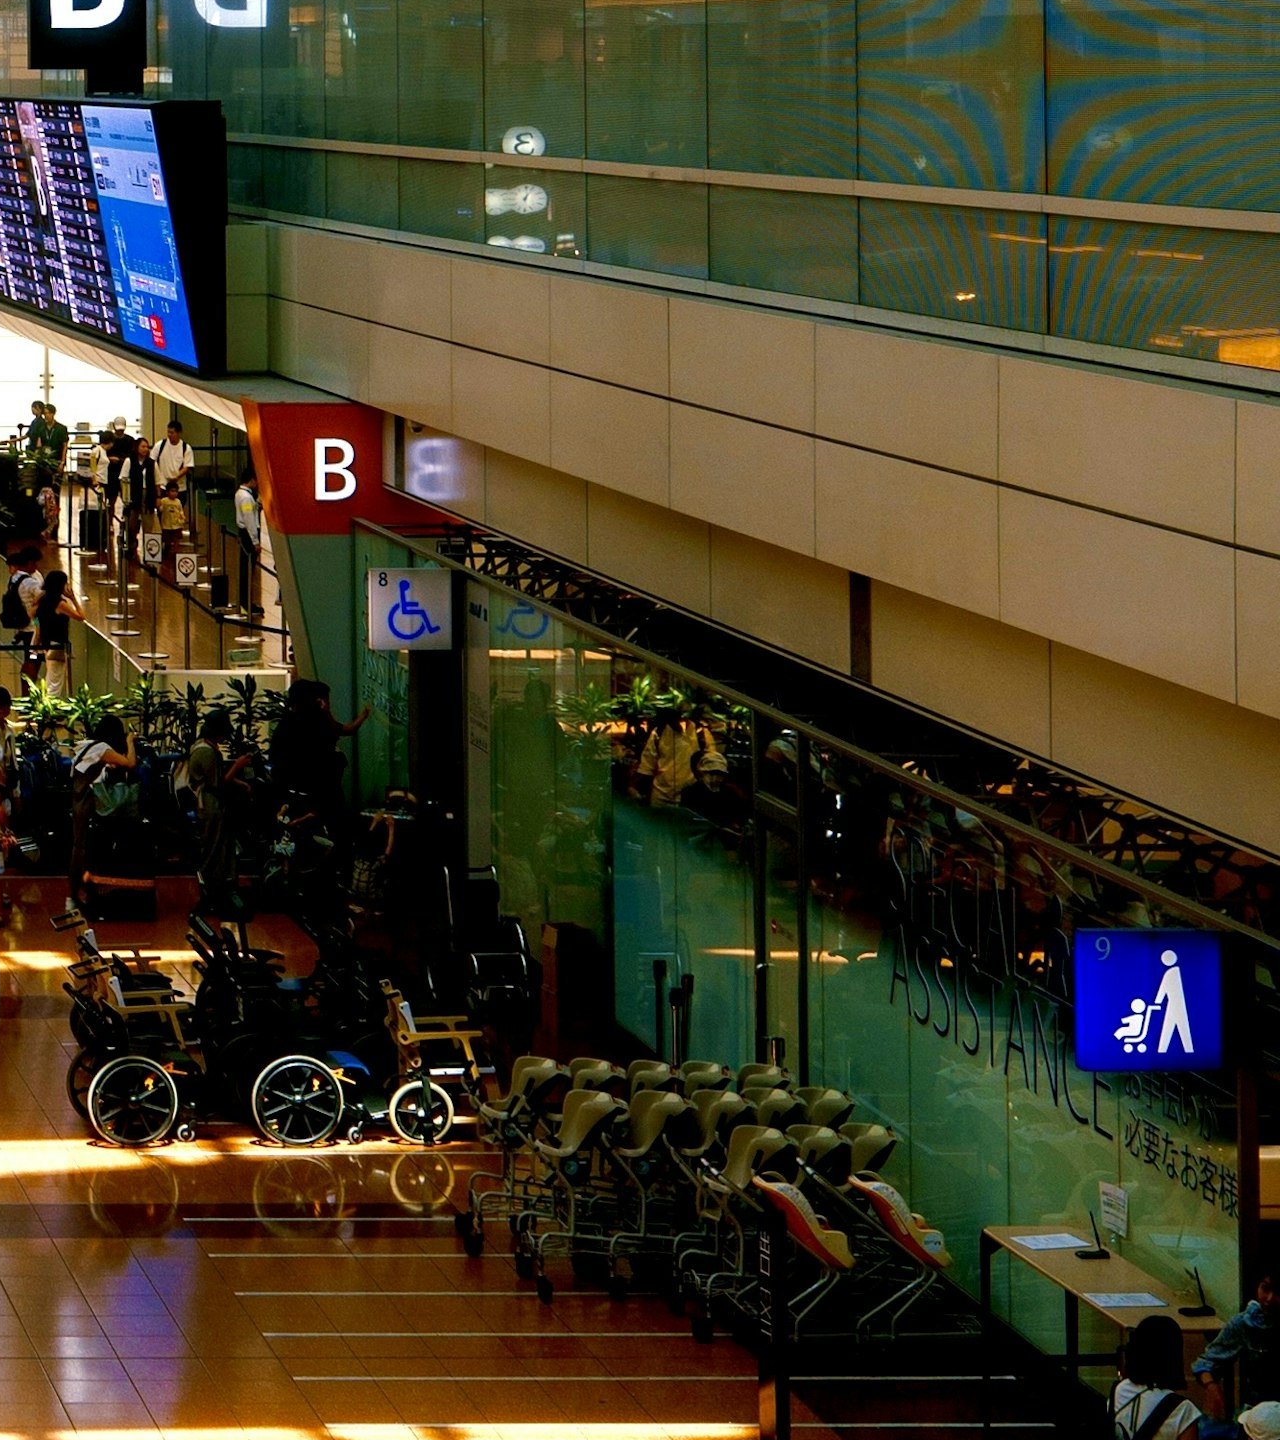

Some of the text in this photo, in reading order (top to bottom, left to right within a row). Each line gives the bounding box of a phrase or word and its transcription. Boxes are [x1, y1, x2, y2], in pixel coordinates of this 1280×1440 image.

[314, 438, 357, 502] B
[378, 572, 388, 587] 8
[889, 827, 1035, 988] SPECIAL
[1095, 936, 1111, 961] 9
[889, 924, 1114, 1141] ASSISTANCE
[1124, 1109, 1240, 1219] 必要なお客様
